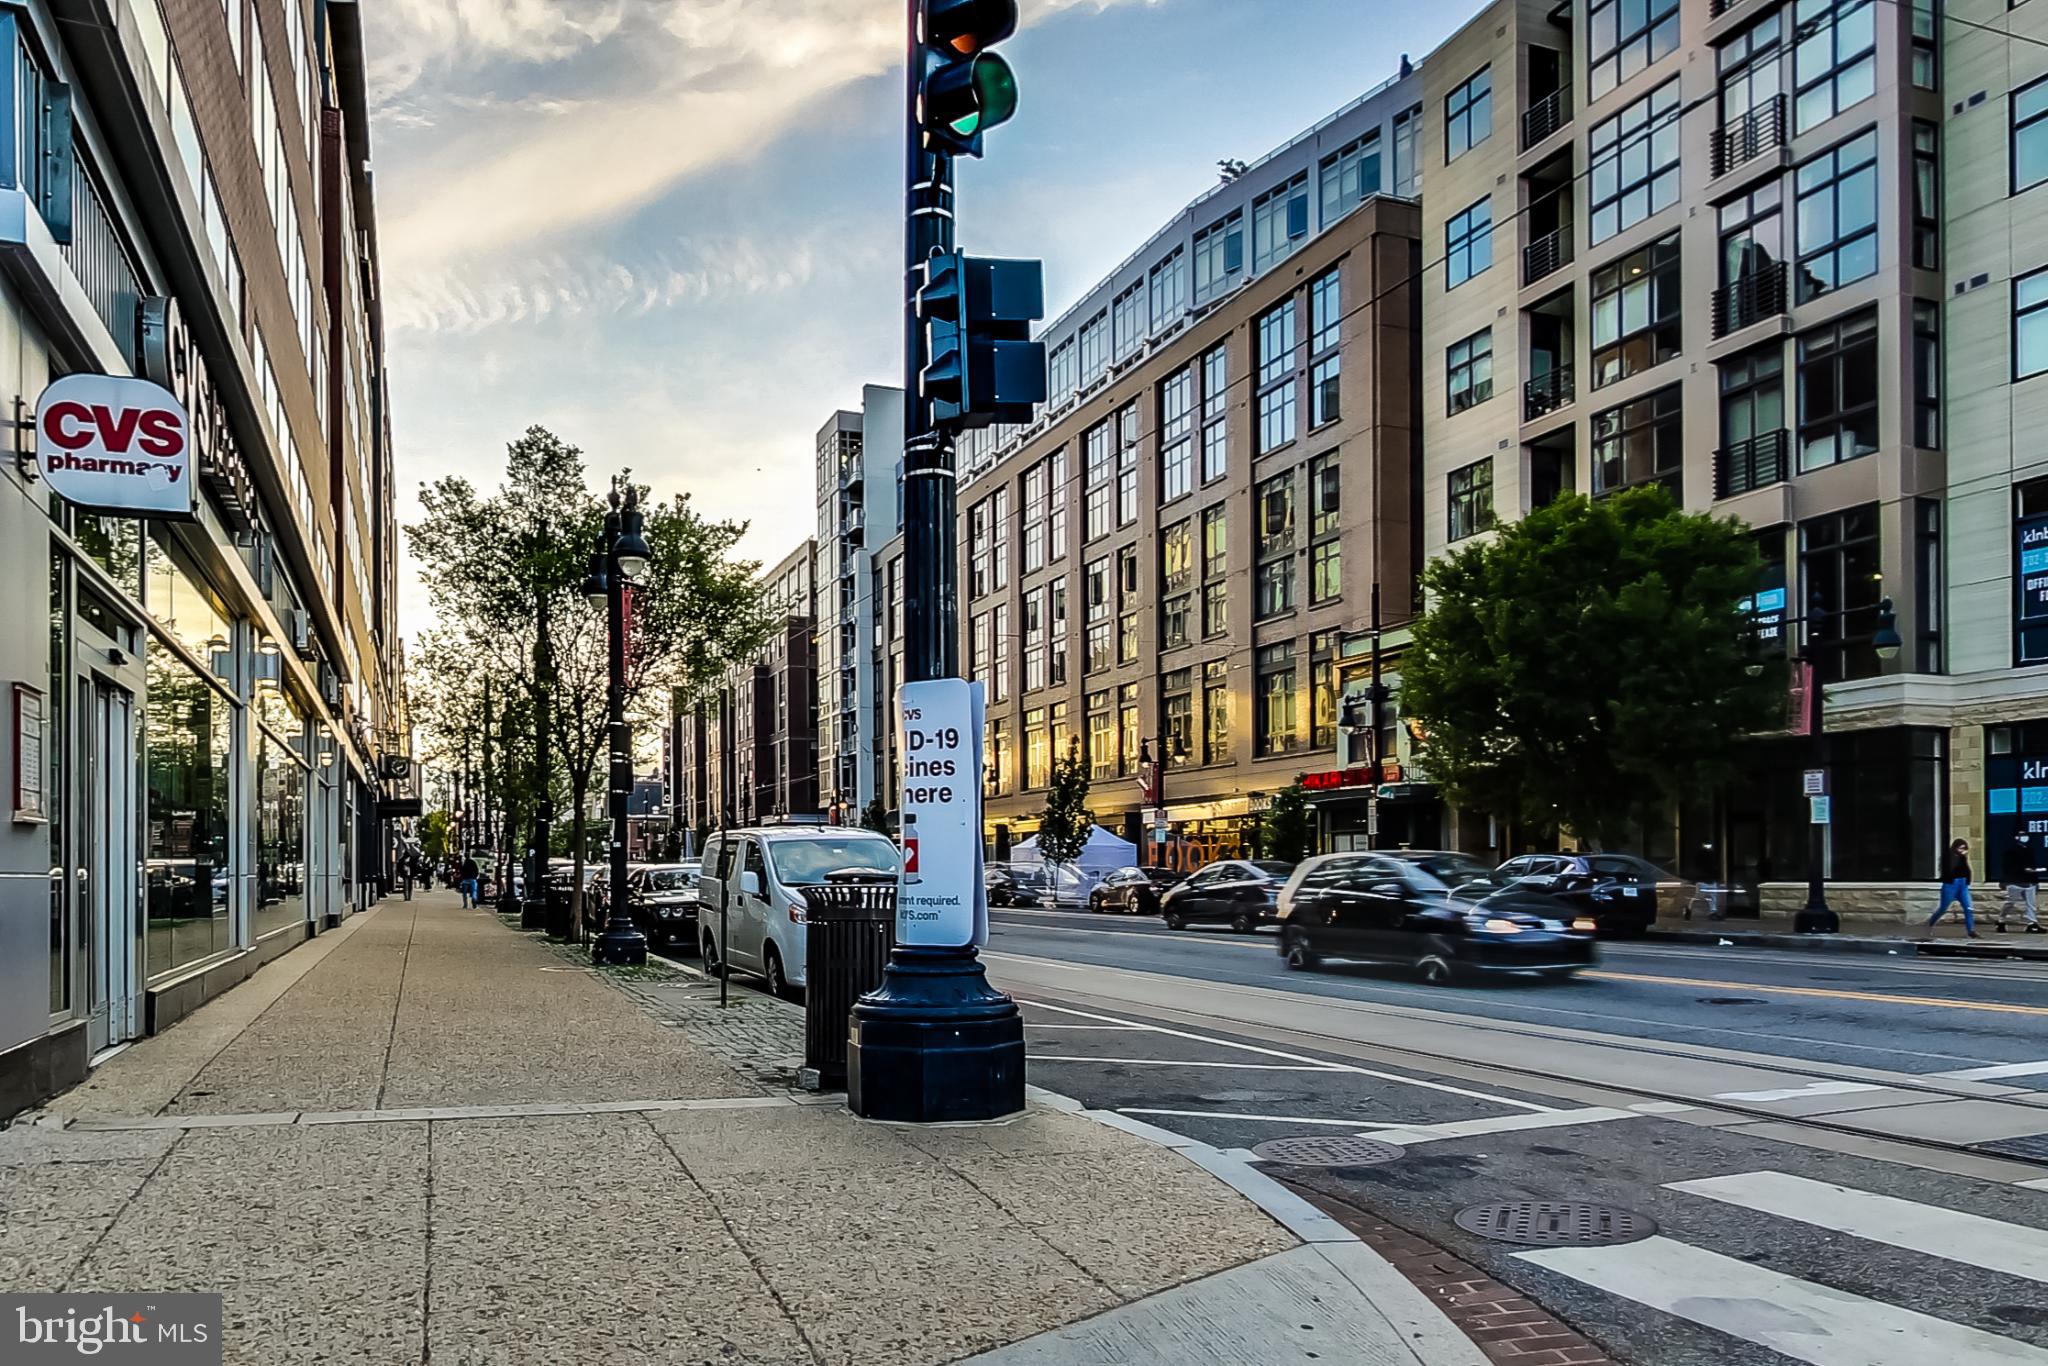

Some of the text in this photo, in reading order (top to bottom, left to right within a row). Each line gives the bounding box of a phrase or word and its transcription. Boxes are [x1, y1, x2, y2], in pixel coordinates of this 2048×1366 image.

[44, 401, 184, 457] CVS
[47, 452, 183, 483] pharmay
[916, 895, 960, 907] required.
